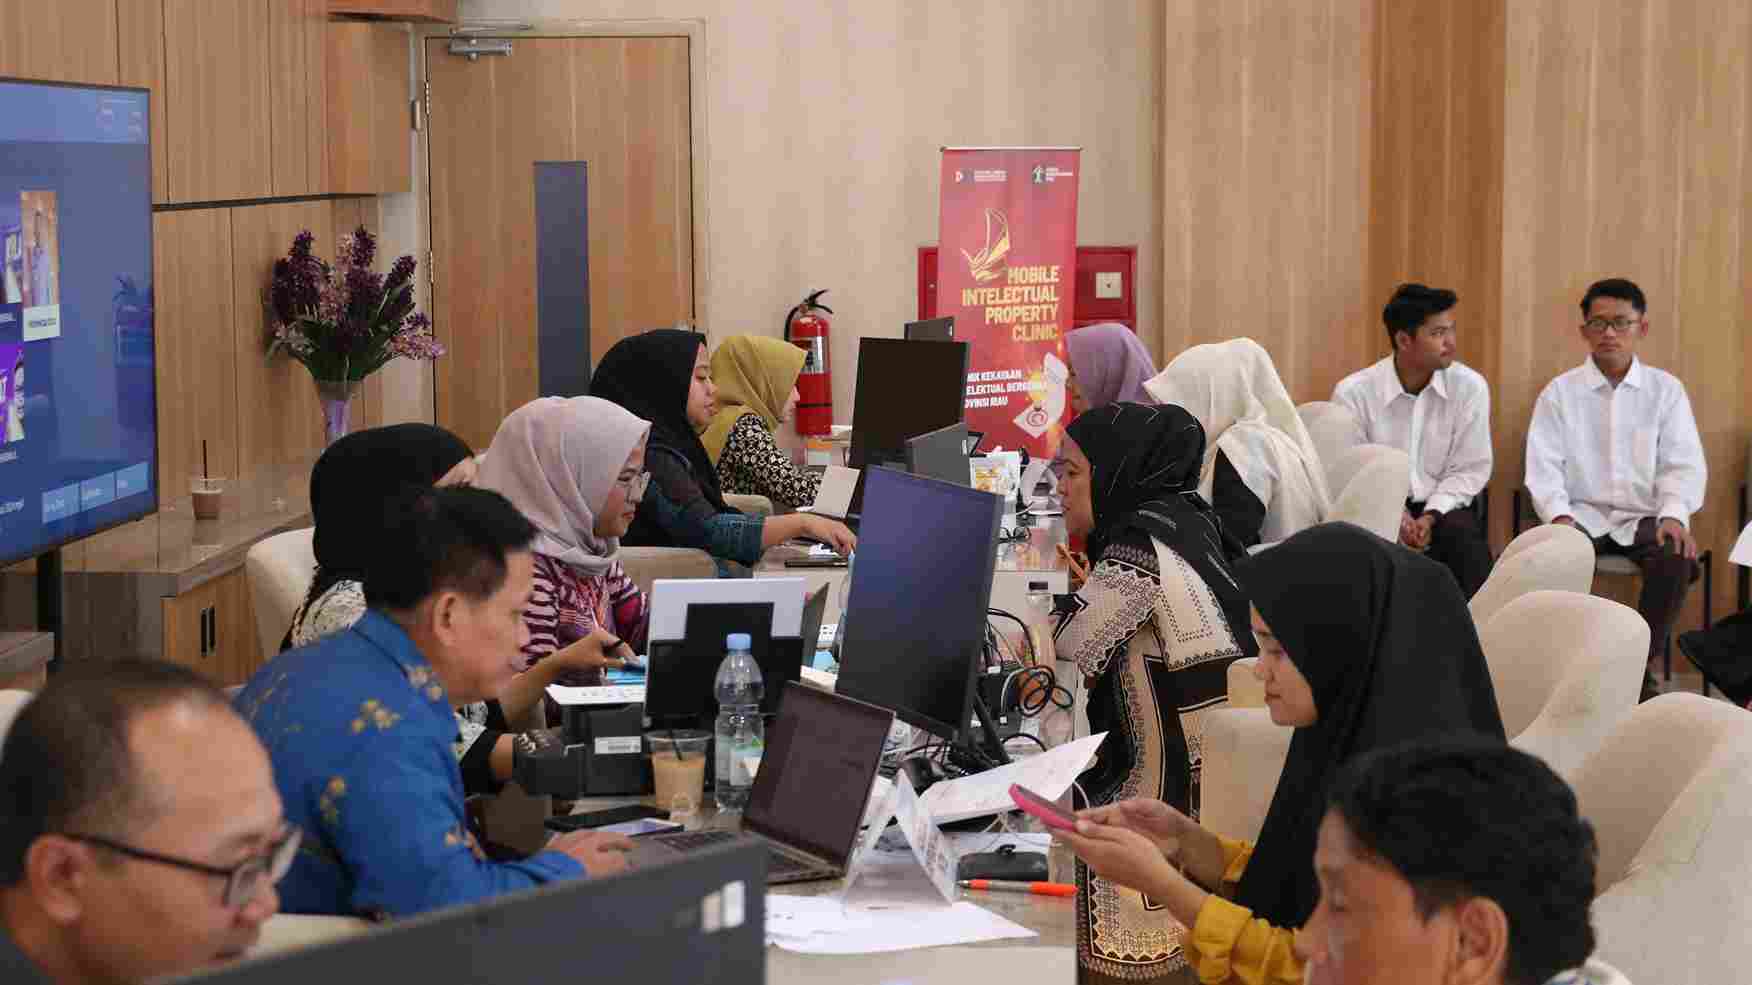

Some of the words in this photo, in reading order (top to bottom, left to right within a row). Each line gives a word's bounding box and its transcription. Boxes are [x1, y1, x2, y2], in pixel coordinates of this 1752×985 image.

[1007, 265, 1060, 284] MOBILE
[961, 285, 1060, 306] INTELECTUAL
[984, 303, 1059, 325] PROPERTY
[1012, 323, 1059, 342] CLINIC
[966, 383, 1006, 396] ELEKTUAL
